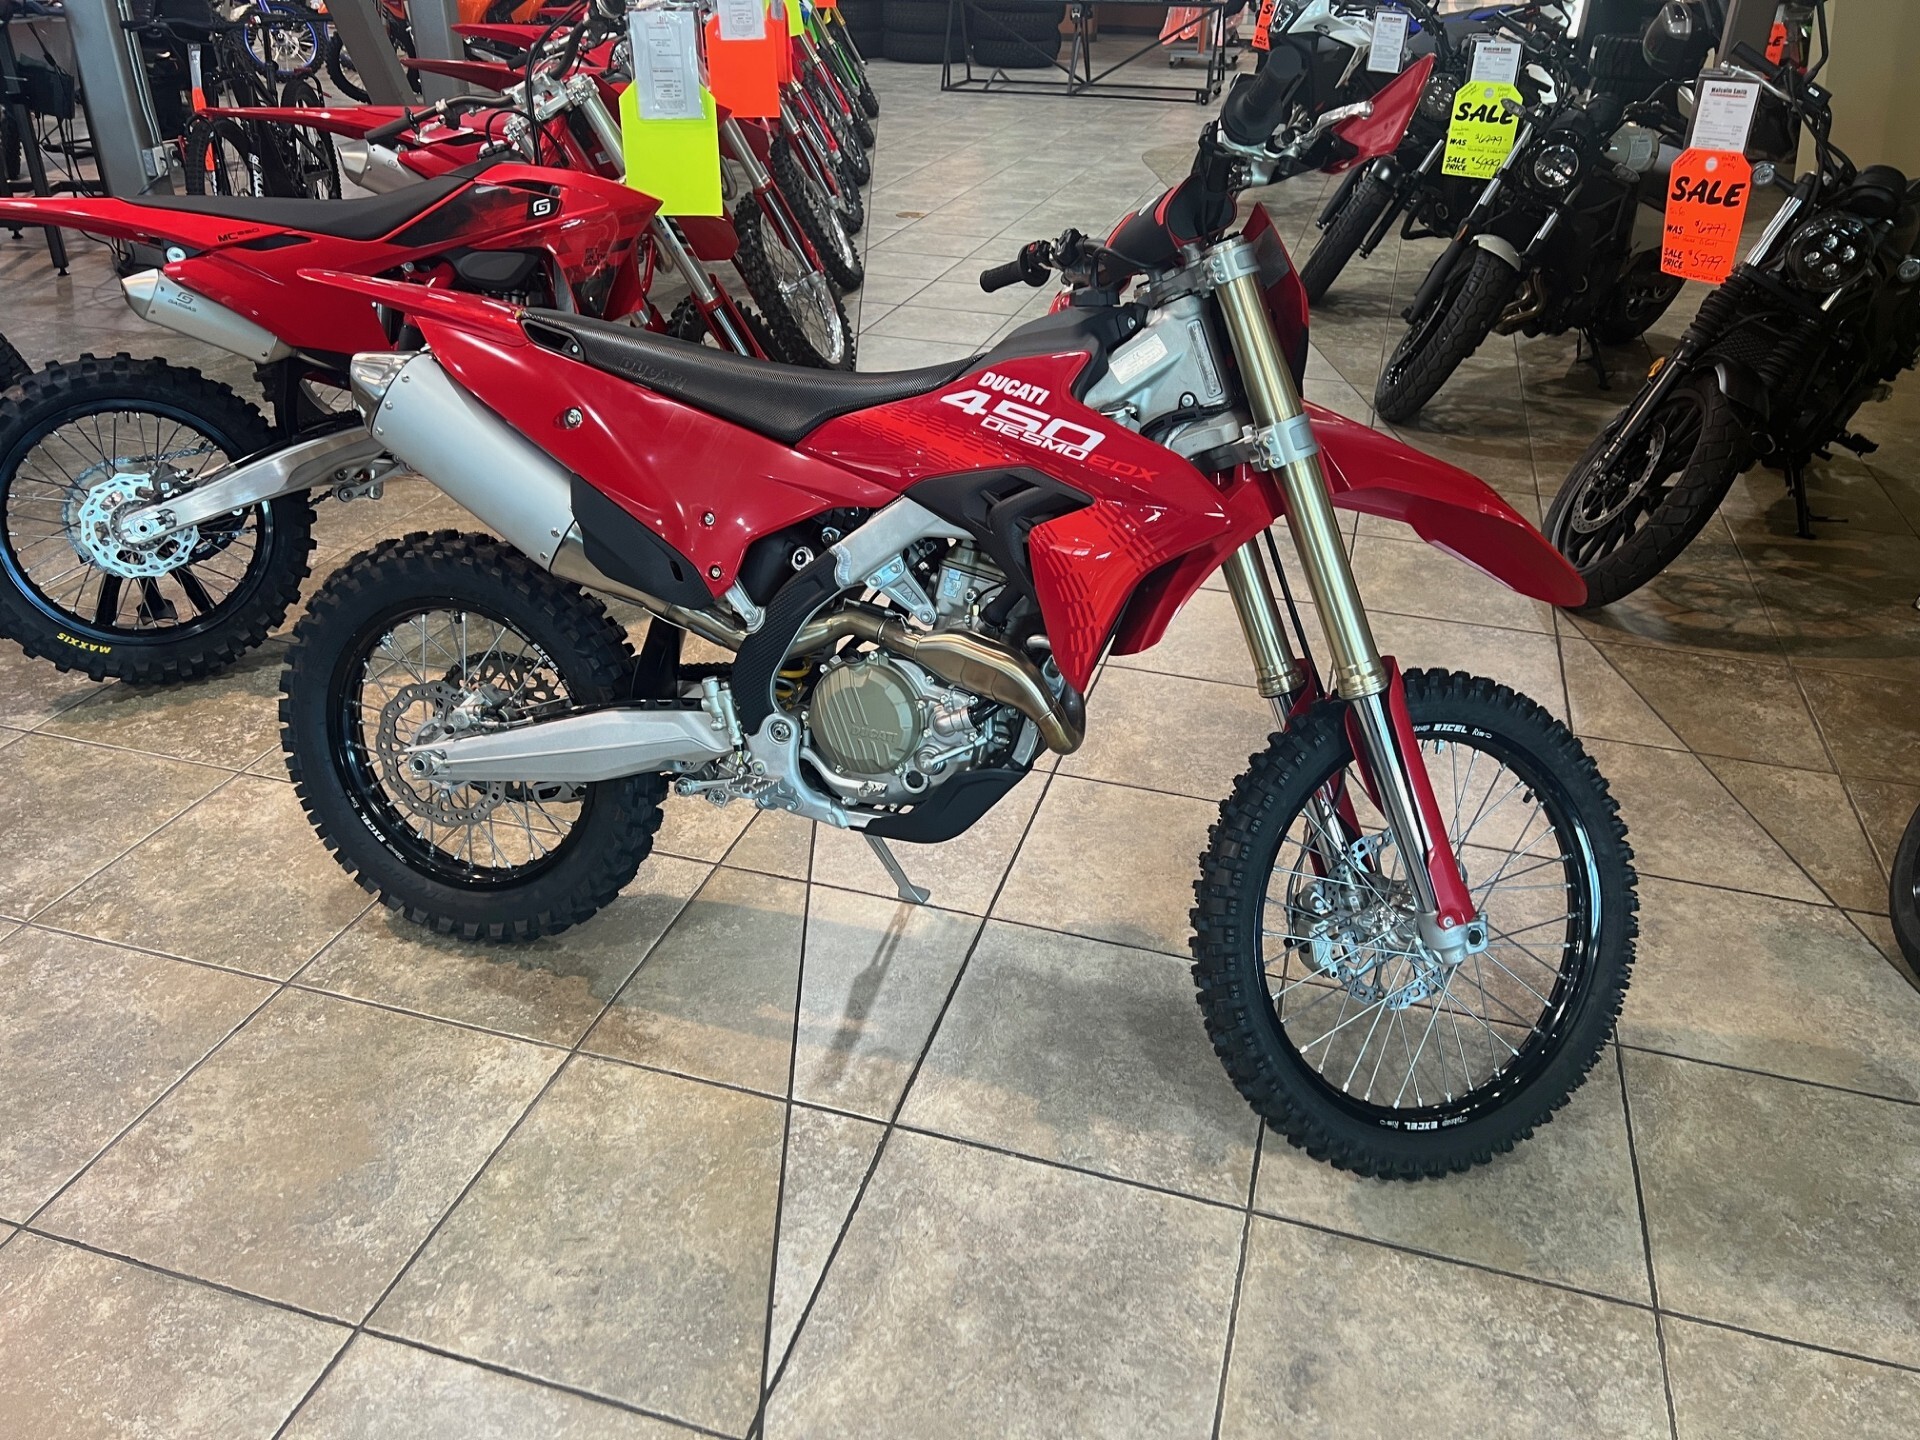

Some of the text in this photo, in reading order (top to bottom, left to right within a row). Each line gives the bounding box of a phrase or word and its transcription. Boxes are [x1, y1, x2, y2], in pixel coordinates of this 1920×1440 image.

[1455, 102, 1514, 125] SALE
[1445, 163, 1467, 171] PRICE
[1446, 156, 1466, 164] SALE
[1671, 176, 1746, 207] SALE
[1666, 224, 1683, 235] WAS
[1663, 258, 1683, 269] PRICE
[1664, 247, 1683, 260] SALE
[977, 371, 1050, 406] DUCATI
[940, 389, 1106, 452] 450
[980, 415, 1160, 482] DESMO EDX
[56, 632, 112, 654] MAXXIS
[532, 643, 559, 675] EXCEL
[851, 724, 898, 743] DUCATI
[1433, 723, 1468, 734] EXCEL
[1472, 727, 1486, 737] Rim
[361, 812, 386, 843] EXCEL
[1404, 1120, 1438, 1130] EXCEL
